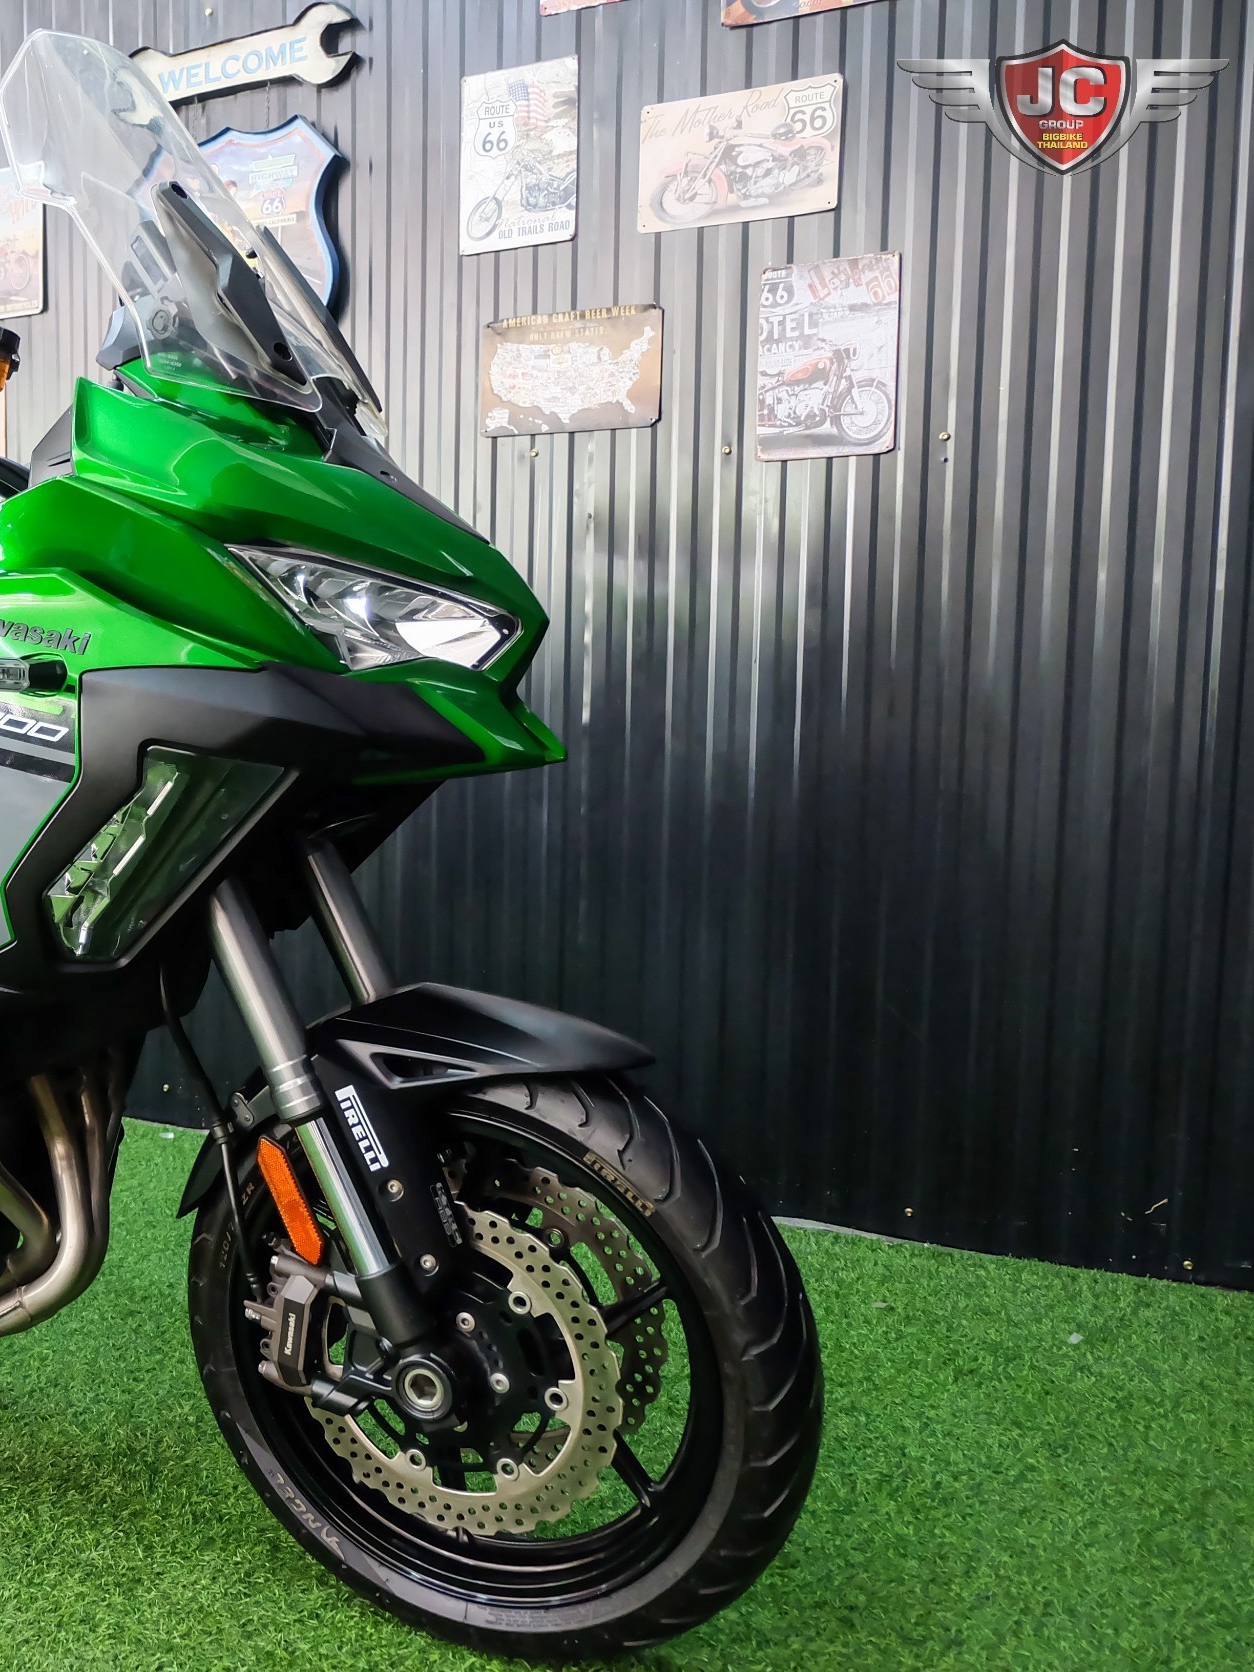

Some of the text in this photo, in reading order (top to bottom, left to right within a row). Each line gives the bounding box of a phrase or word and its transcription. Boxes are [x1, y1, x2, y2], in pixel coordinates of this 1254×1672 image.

[158, 37, 308, 94] WELCOME
[794, 92, 825, 103] ROUTE
[484, 104, 510, 116] ROUTE
[642, 88, 784, 144] The Mother Road
[790, 105, 827, 135] 66
[489, 121, 504, 129] US
[482, 131, 509, 152] 66
[262, 198, 282, 214] 66
[496, 211, 559, 229] National
[498, 220, 570, 239] OLD TRAILS ROAD
[761, 283, 788, 306] 66
[503, 314, 548, 328] AMERICAN
[552, 311, 581, 324] CRAFT
[585, 309, 607, 320] BEER
[611, 305, 636, 317] WEEK
[335, 1084, 389, 1172] PIRELLI
[583, 1151, 655, 1217] PIRELLI
[284, 1312, 296, 1355] Kawasaki
